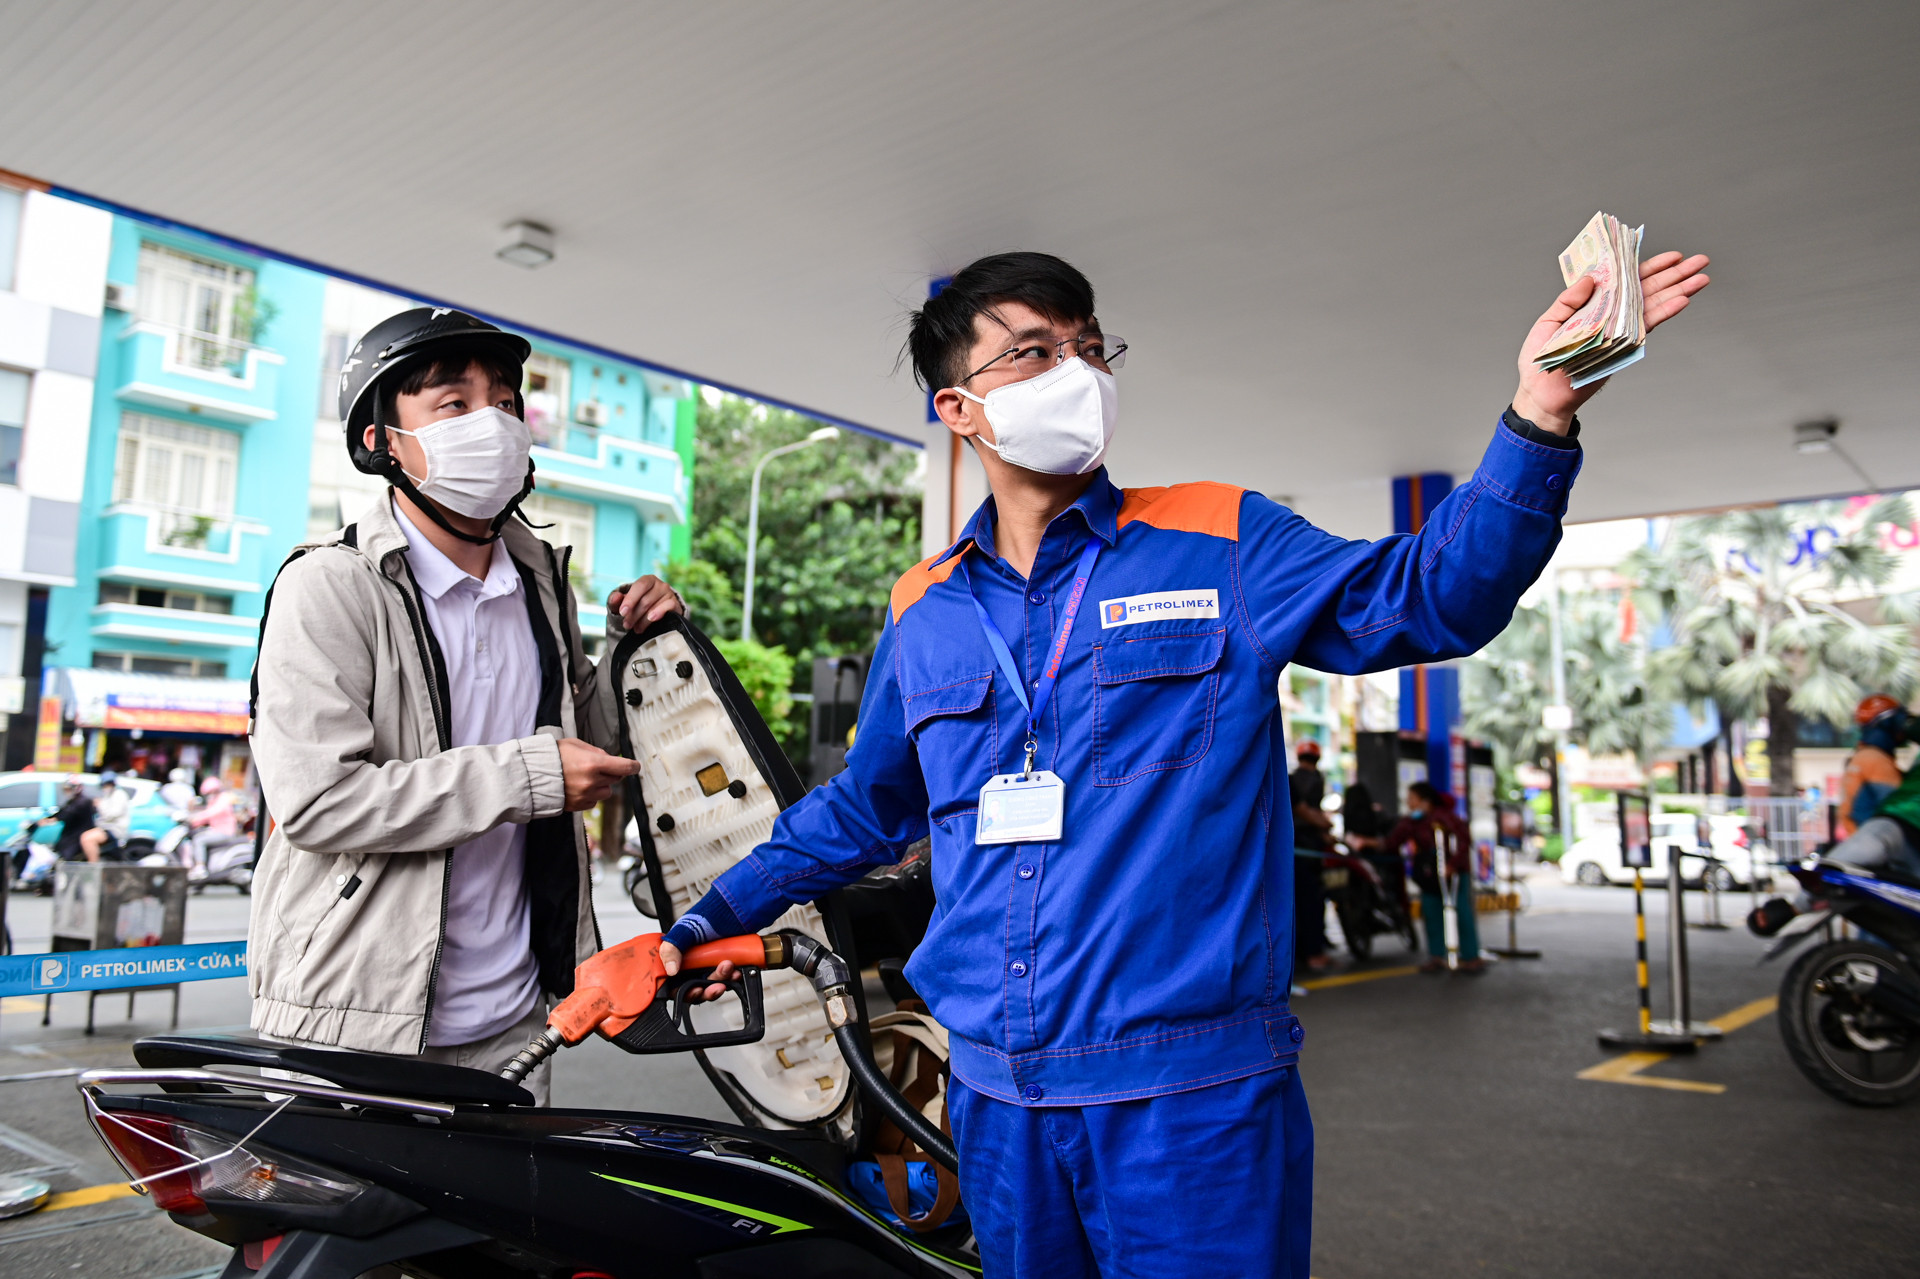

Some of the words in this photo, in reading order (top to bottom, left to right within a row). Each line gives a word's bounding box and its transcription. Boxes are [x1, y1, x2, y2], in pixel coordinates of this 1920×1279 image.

[1129, 600, 1214, 613] PETROLIMEX
[1046, 617, 1073, 679] Petrolimex
[81, 957, 186, 978] PETROLIMEX
[198, 952, 230, 969] CỬA
[731, 1218, 764, 1234] FI
